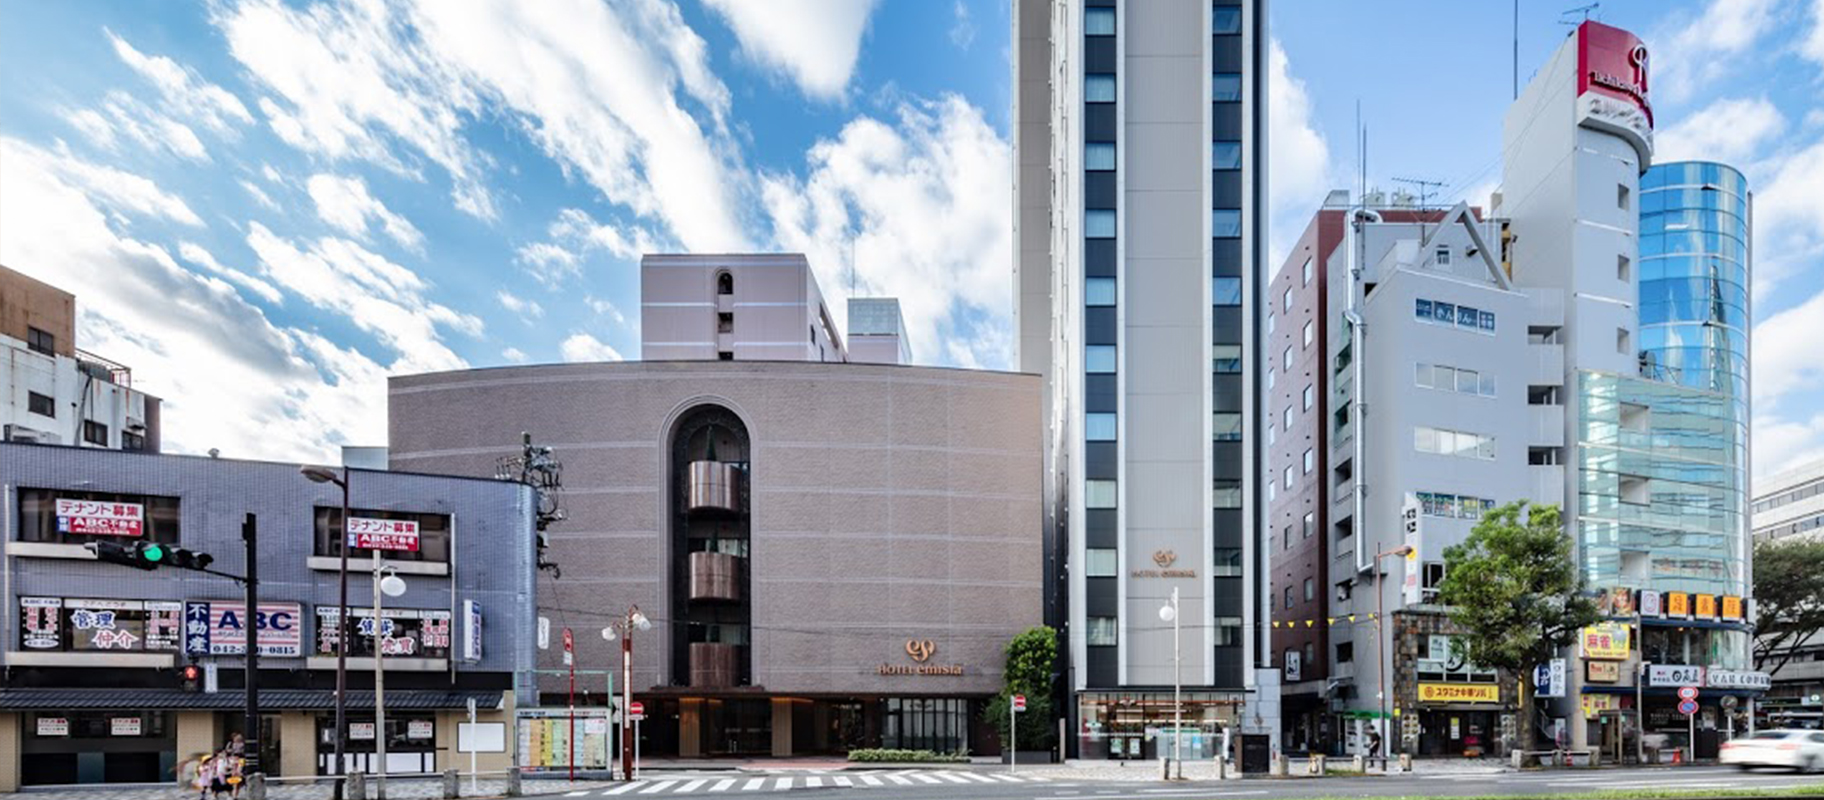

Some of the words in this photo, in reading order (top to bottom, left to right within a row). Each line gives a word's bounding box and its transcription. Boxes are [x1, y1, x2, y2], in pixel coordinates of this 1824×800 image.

[60, 501, 138, 517] テナント募集
[350, 520, 415, 533] テナント募集
[73, 611, 114, 628] 管理
[187, 603, 208, 653] 不動産
[95, 630, 137, 649] 仲介
[1587, 634, 1610, 648] 麻雀
[878, 664, 912, 675] HOTEL
